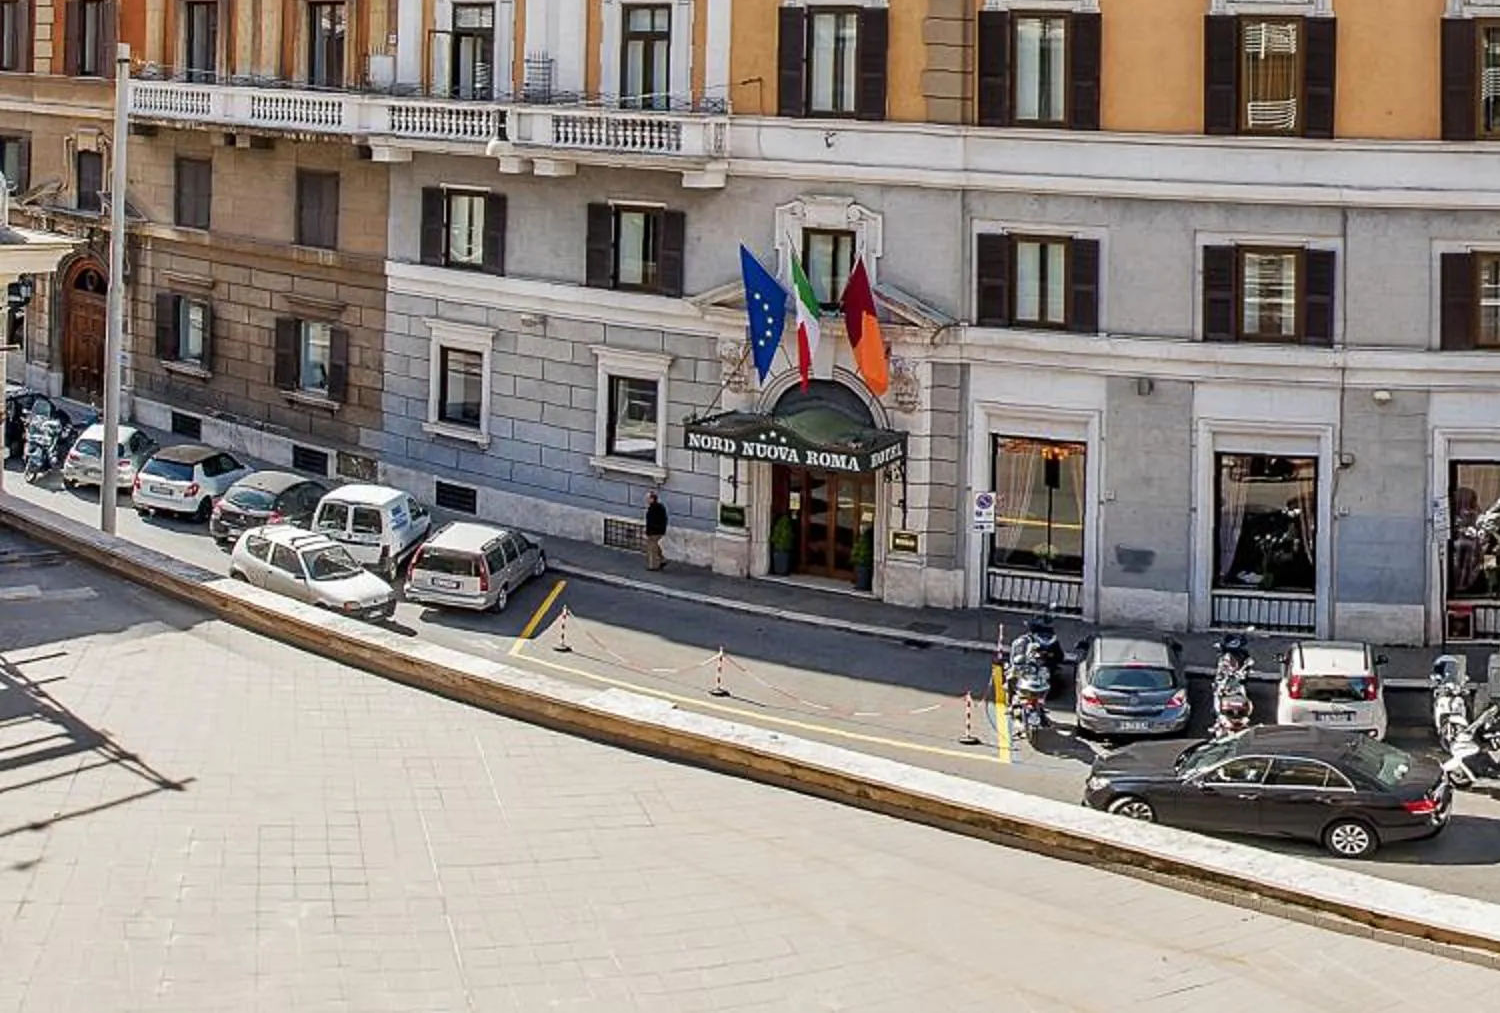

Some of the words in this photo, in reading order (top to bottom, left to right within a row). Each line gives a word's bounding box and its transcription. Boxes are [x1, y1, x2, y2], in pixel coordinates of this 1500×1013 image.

[688, 433, 736, 454] NORD
[742, 442, 799, 464] NUOVA
[805, 450, 861, 472] ROMA
[870, 442, 903, 468] HOTEL
